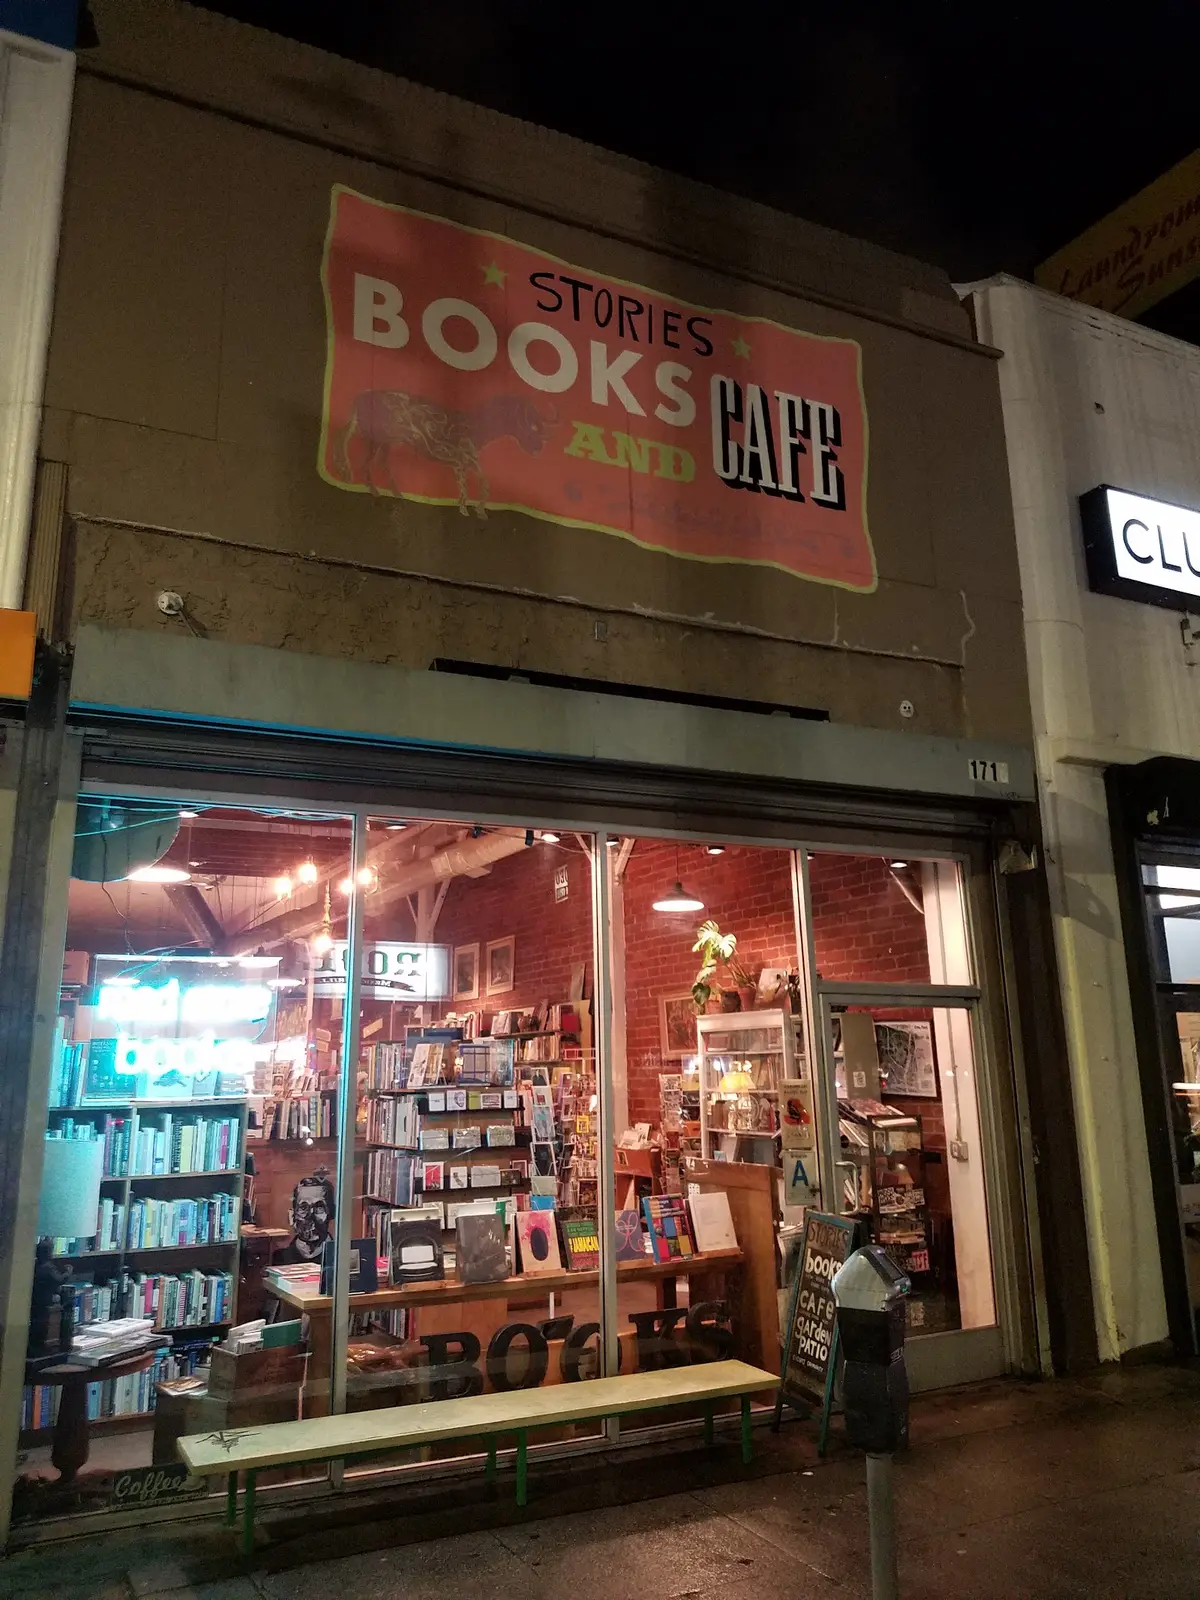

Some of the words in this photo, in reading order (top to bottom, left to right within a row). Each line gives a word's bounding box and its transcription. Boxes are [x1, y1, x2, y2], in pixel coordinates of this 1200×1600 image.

[529, 272, 714, 357] STORIES
[353, 273, 697, 427] BOOKS
[564, 420, 696, 483] AND
[710, 374, 846, 511] CAFE
[970, 760, 998, 783] 171
[791, 1159, 809, 1187] A
[114, 1470, 183, 1501] Coffee
